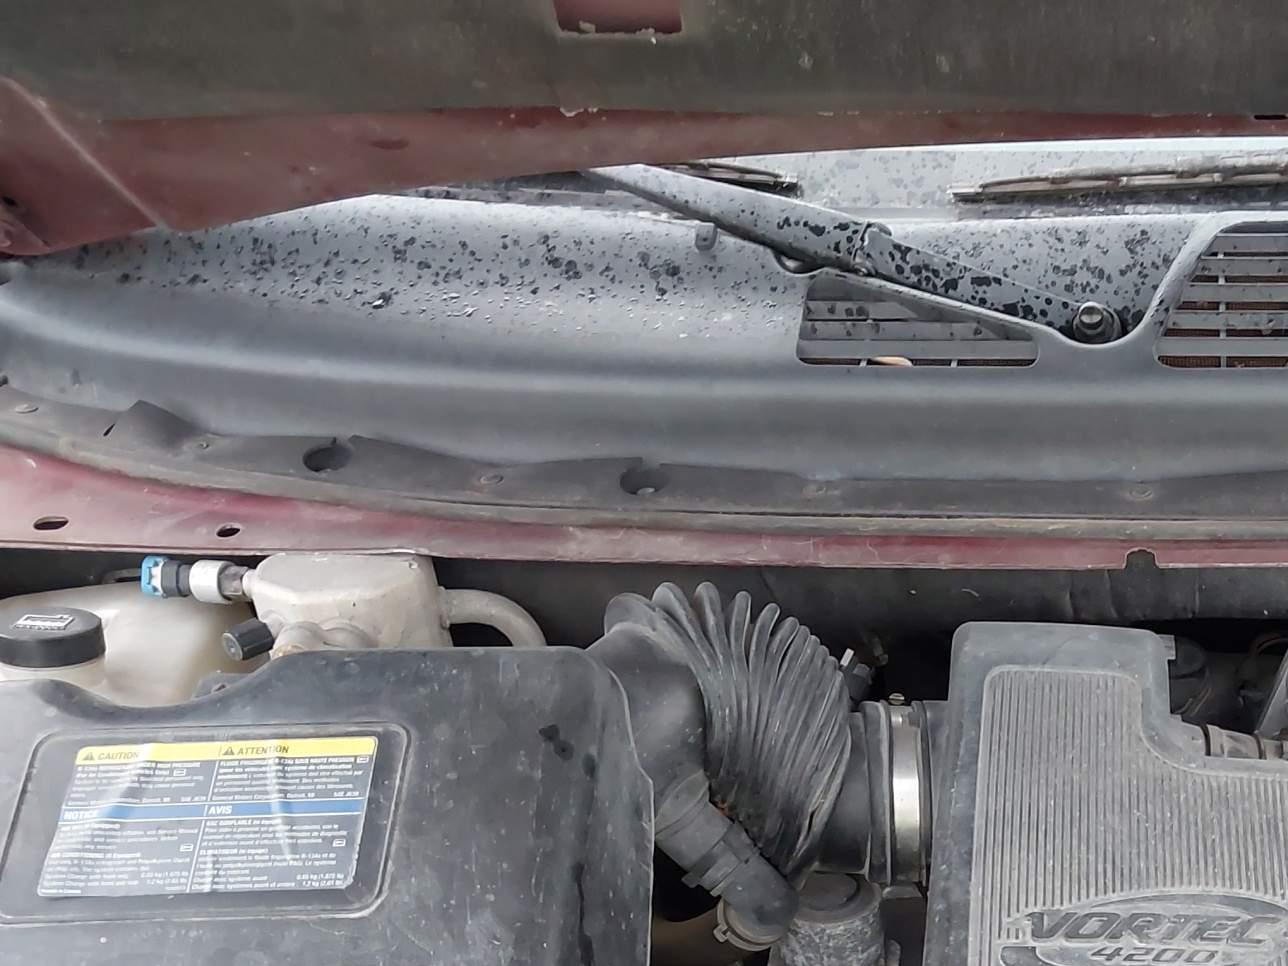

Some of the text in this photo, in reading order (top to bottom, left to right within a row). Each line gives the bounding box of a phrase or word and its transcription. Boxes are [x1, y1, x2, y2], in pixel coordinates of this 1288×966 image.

[97, 751, 140, 761] CAUTION
[236, 745, 290, 756] ATTENTION
[208, 805, 233, 815] AVIS
[1025, 911, 1281, 945] VORTEC
[1090, 947, 1219, 963] 4200
